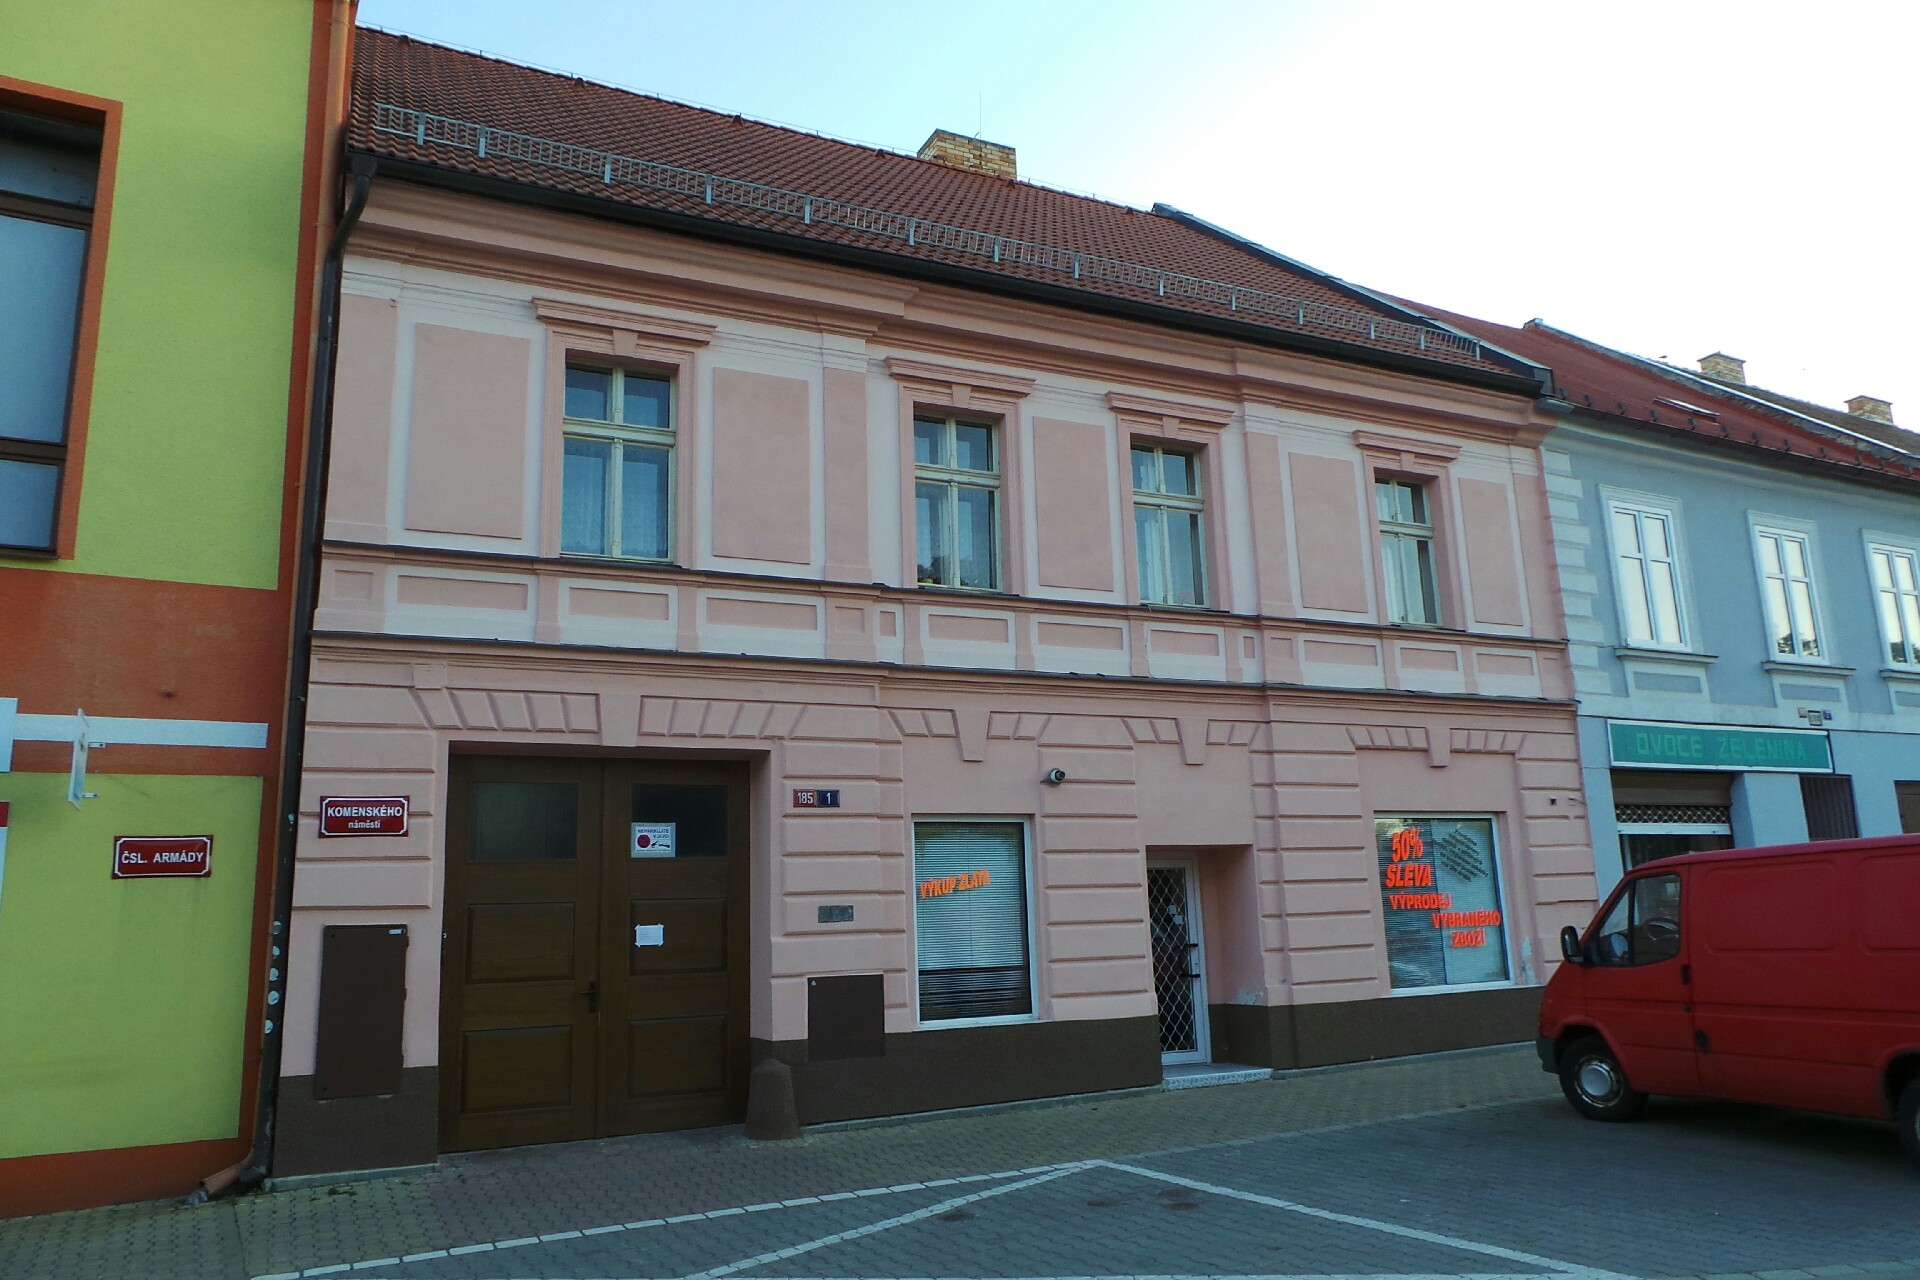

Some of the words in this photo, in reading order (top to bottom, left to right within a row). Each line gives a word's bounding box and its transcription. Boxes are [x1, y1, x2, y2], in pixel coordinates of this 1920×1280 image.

[1636, 732, 1703, 758] OVOCE
[1716, 737, 1806, 760] ZELENINA
[797, 792, 814, 804] 185
[826, 792, 831, 805] 1
[327, 805, 403, 817] KOMENSKÉHO
[348, 820, 381, 829] náměstí
[1391, 827, 1424, 862] 50%
[121, 850, 148, 864] ČSL.
[152, 849, 204, 863] ARMÁDY
[920, 876, 957, 899] VÝKUP
[958, 868, 991, 891] ZLATA
[1386, 864, 1432, 888] SLEVA
[1389, 890, 1452, 910] VÝPRODEJ
[1431, 908, 1501, 928] VYBRANÉHO
[1451, 928, 1486, 948] ZBOŽÍ
